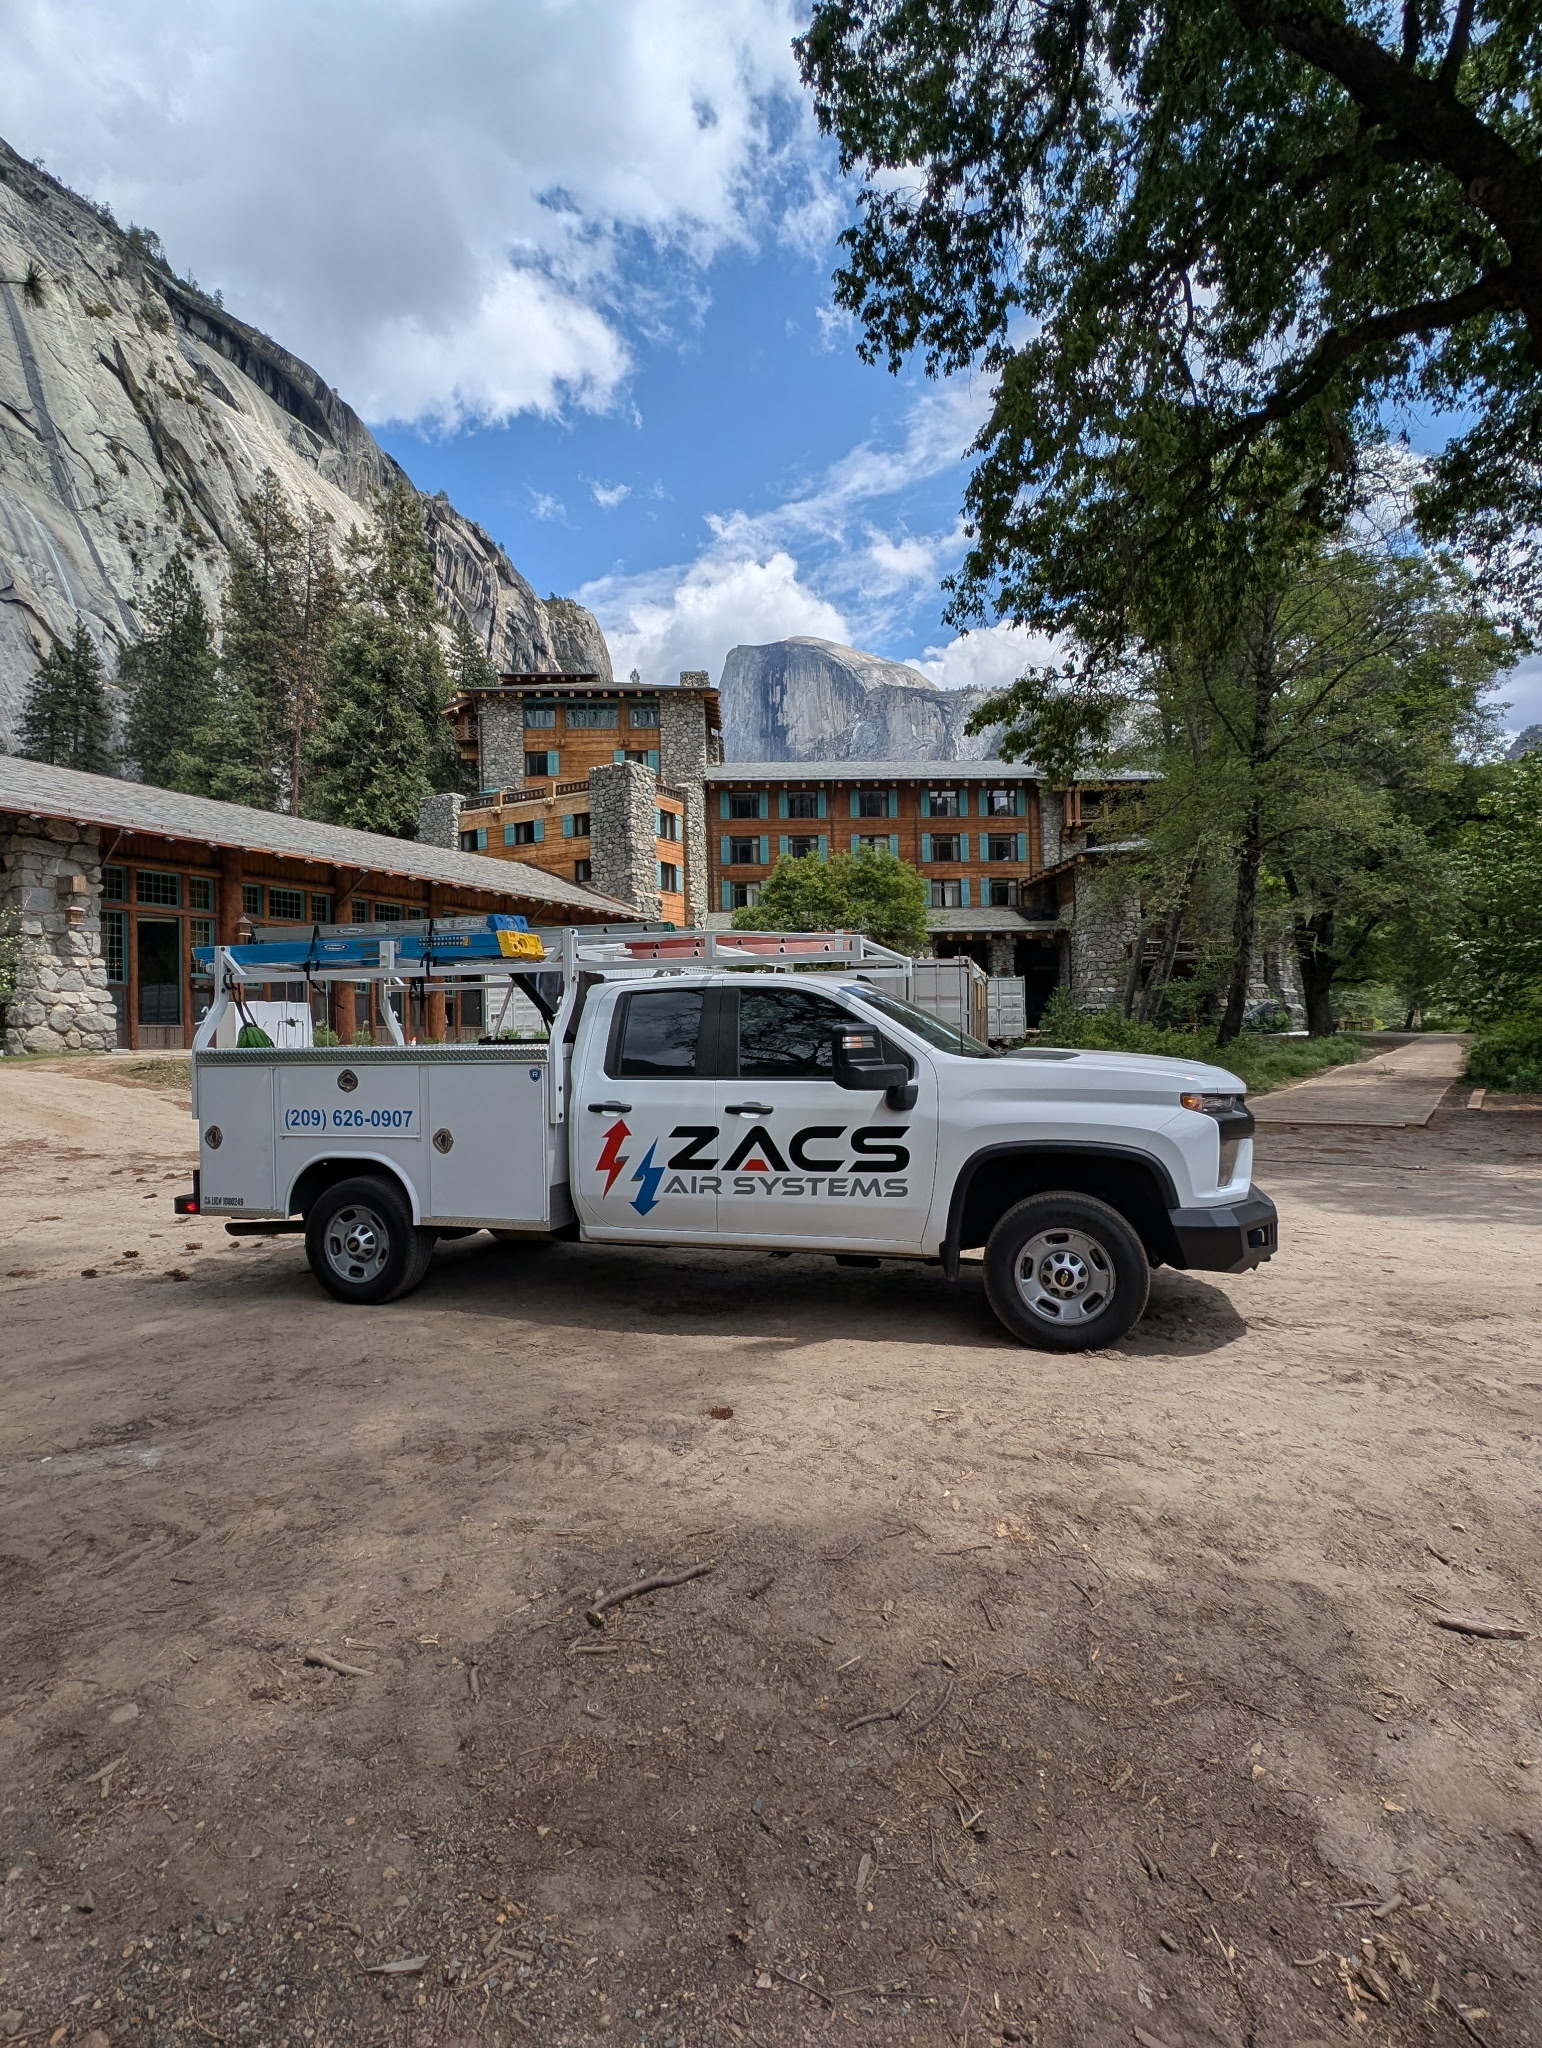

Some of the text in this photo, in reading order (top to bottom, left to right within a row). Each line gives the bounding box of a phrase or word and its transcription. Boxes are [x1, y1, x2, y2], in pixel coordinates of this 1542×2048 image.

[285, 1109, 413, 1131] (209) 626-0907
[667, 1125, 911, 1173] ZACS
[663, 1176, 909, 1198] AIR SYSTEMS
